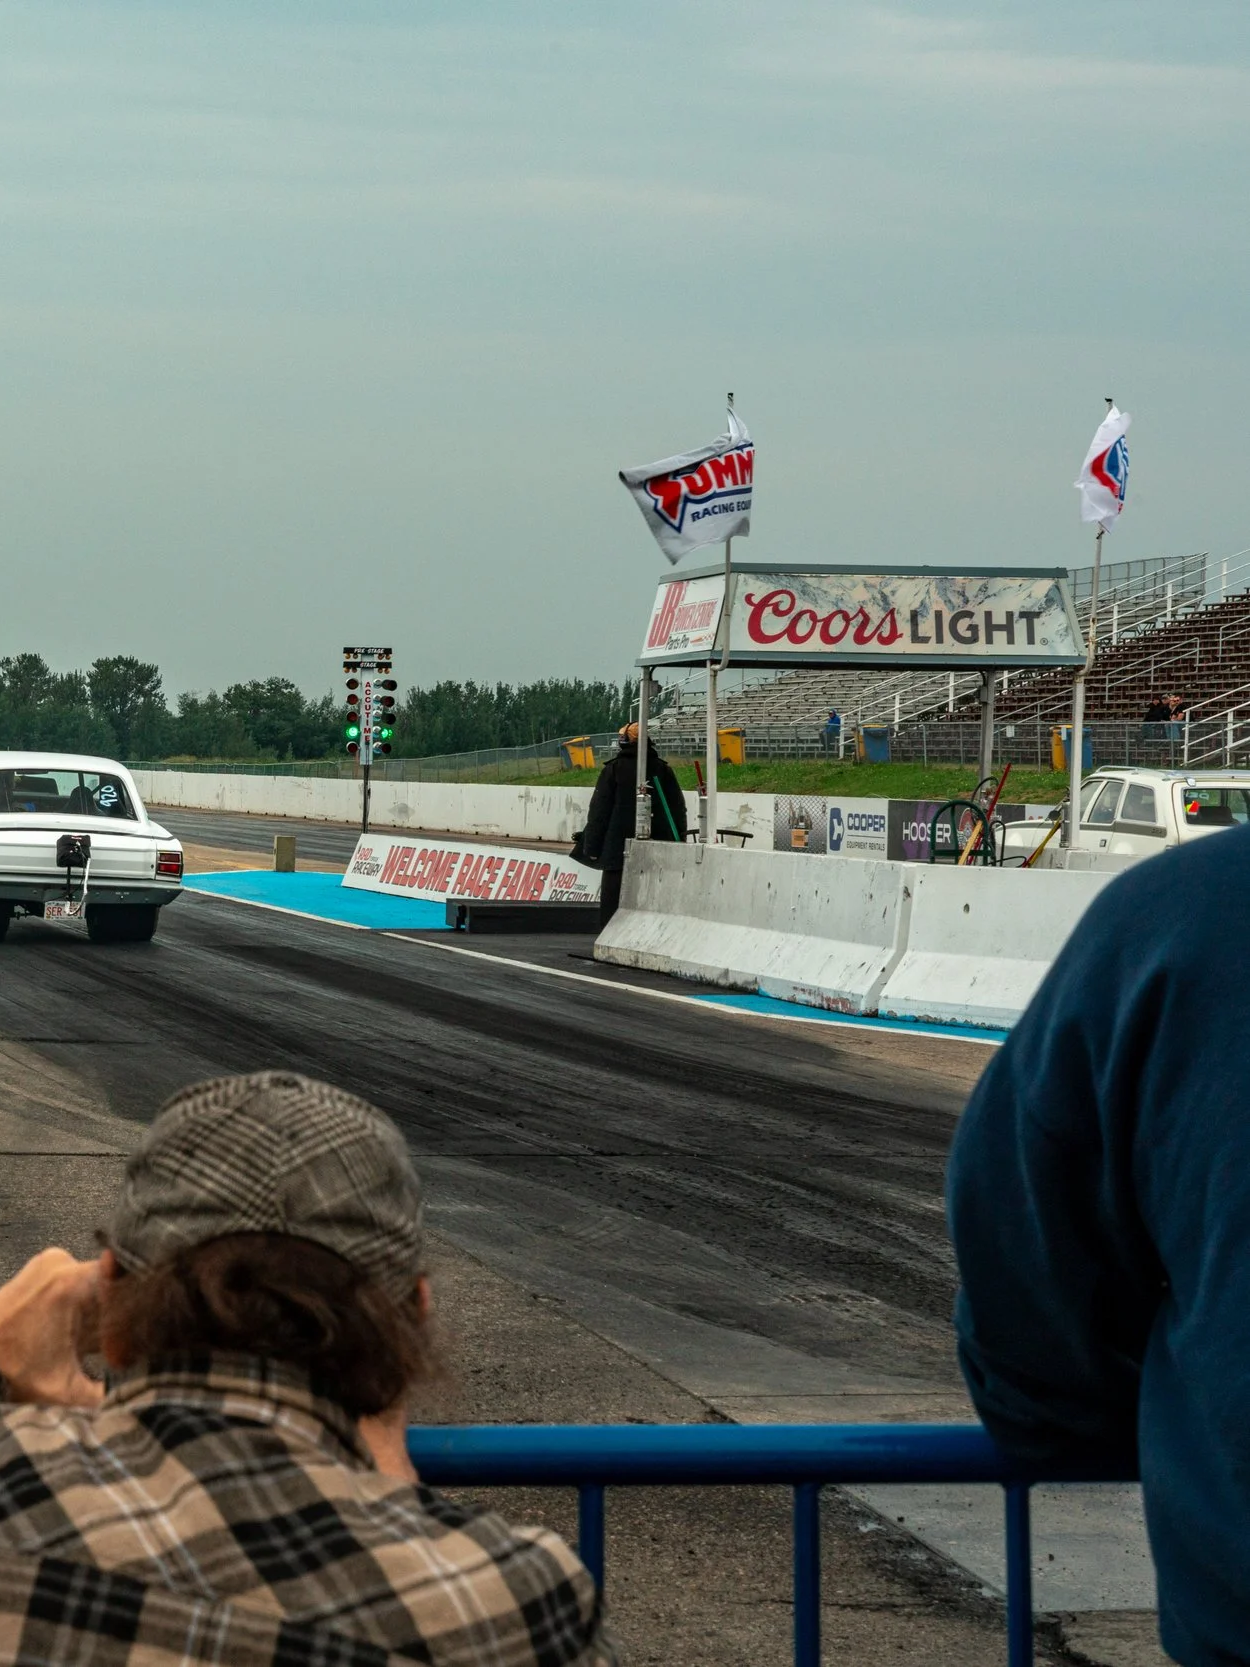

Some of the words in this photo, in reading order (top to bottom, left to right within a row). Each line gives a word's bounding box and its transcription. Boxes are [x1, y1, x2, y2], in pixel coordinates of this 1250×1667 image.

[648, 449, 754, 520] SUMM
[691, 502, 735, 522] RACING
[737, 500, 751, 511] EQU
[745, 589, 903, 645] Coors
[910, 609, 1041, 645] LIGHT
[847, 813, 886, 832] COOPER
[902, 821, 951, 843] HOOSER
[358, 847, 374, 860] RAD
[846, 840, 868, 850] EQUIPMENT
[868, 842, 886, 852] RENTALS
[351, 861, 383, 877] RACEWAY
[379, 845, 461, 893] WELCOME
[451, 853, 506, 899] RACE
[494, 859, 551, 901] FANS
[555, 872, 578, 889] RAD
